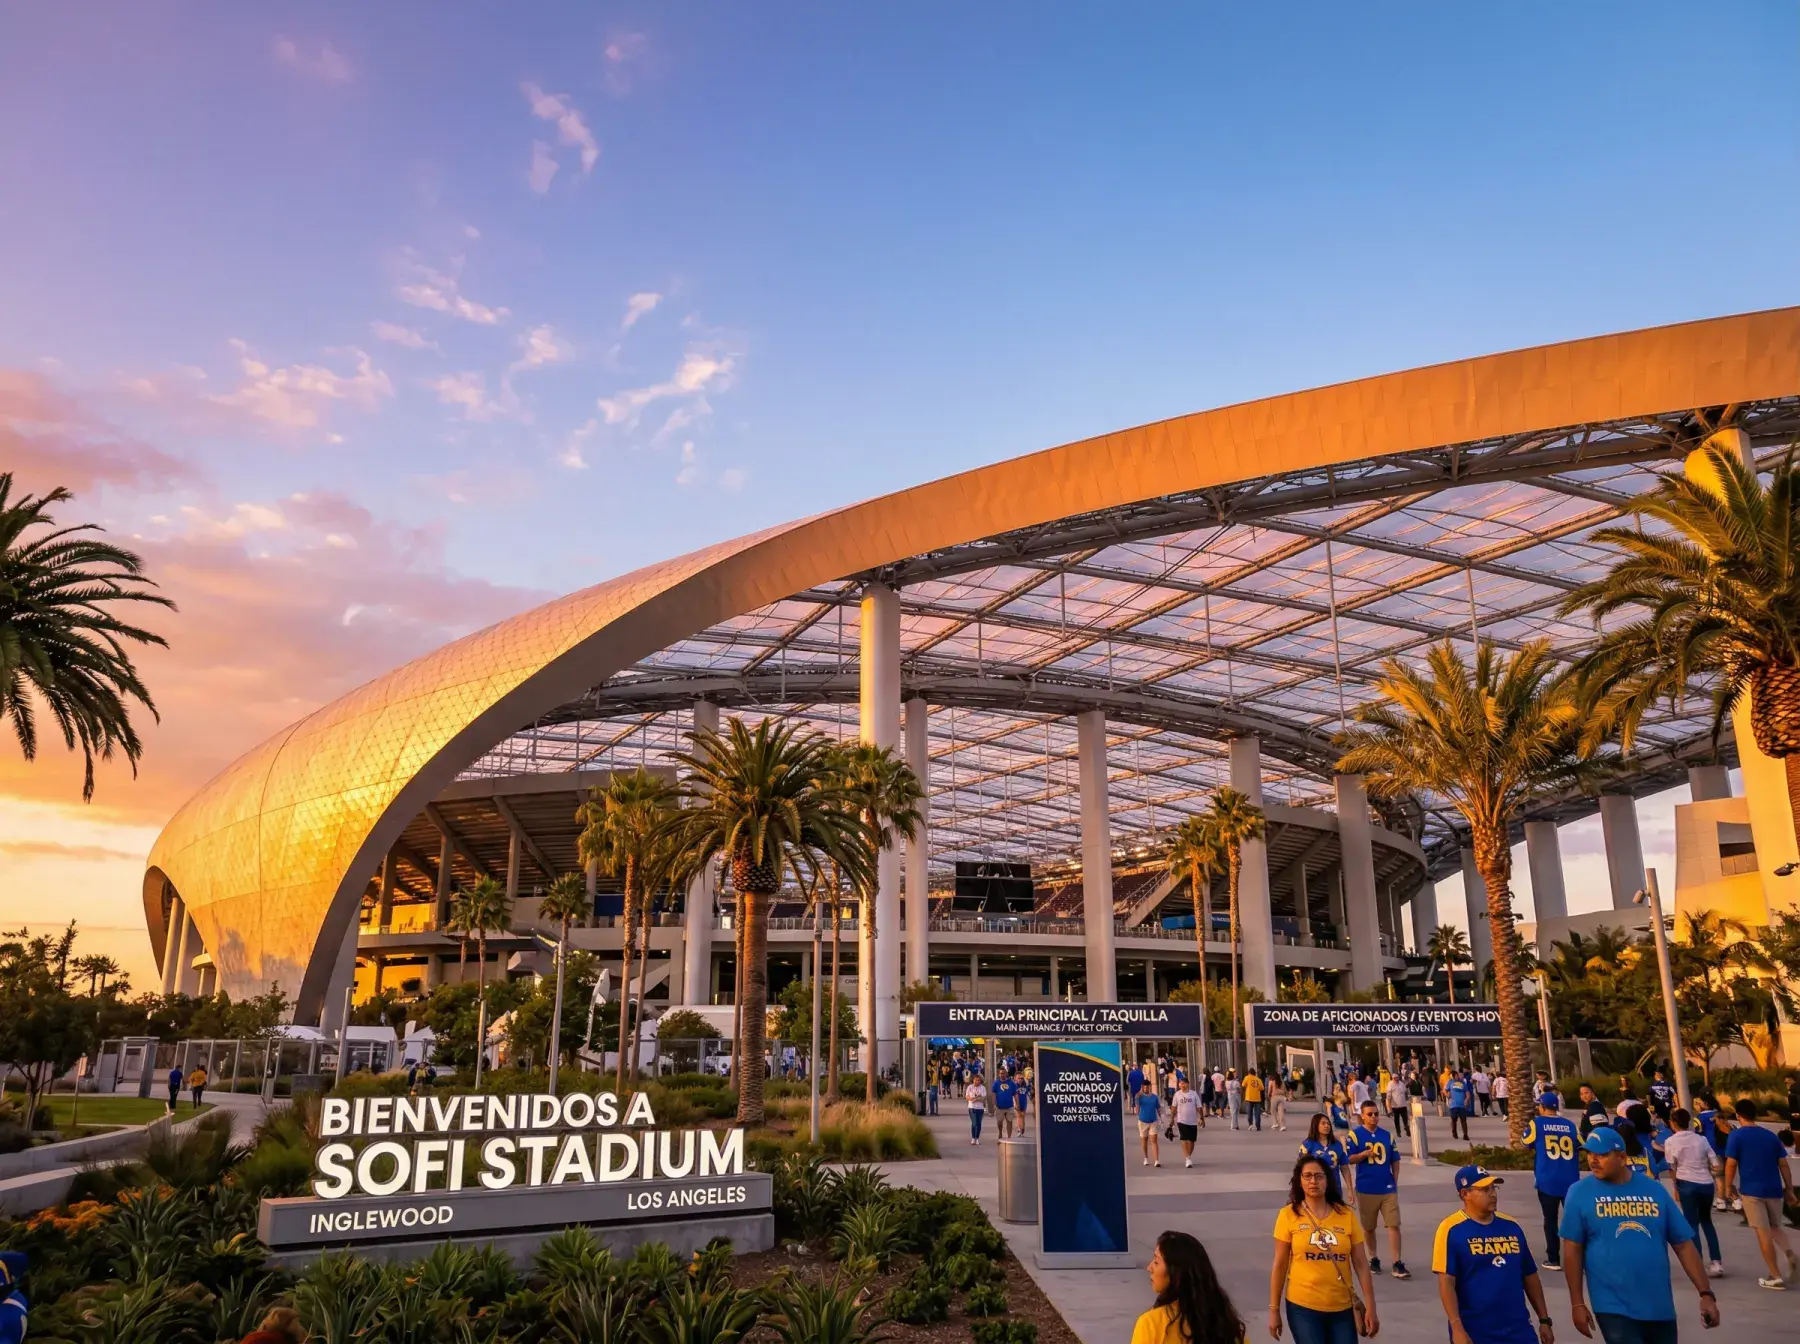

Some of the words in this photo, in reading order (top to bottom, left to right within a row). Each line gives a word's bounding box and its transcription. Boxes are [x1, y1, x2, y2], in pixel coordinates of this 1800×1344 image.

[949, 1009, 1014, 1021] ENTRADA
[1017, 1009, 1089, 1022] PRINCIPAL
[1100, 1009, 1169, 1022] TAQUILLA
[1263, 1010, 1300, 1022] ZONA
[1303, 1010, 1319, 1022] DE
[1321, 1010, 1408, 1022] AFICIONADOS
[1418, 1010, 1474, 1023] EVENTOS
[995, 1023, 1017, 1032] MAIN
[1018, 1023, 1061, 1032] ENTRANCE
[1067, 1023, 1095, 1032] TICKET
[1095, 1023, 1123, 1032] OFFICE
[1349, 1024, 1371, 1032] ZONE
[1410, 1024, 1440, 1032] EVENTS
[1058, 1071, 1087, 1081] ZONA
[1088, 1071, 1102, 1081] DE
[1043, 1083, 1112, 1093] AFICIONADOS
[1046, 1094, 1091, 1104] EVENTOS
[1092, 1093, 1114, 1104] HOY
[321, 1091, 618, 1136] BIENVENIDOS
[625, 1091, 655, 1126] A
[1063, 1106, 1078, 1114] FAN
[1078, 1106, 1098, 1114] ZONE
[1083, 1114, 1111, 1122] EVENTS
[1545, 1134, 1574, 1160] 59
[312, 1138, 465, 1199] SOFI
[481, 1127, 745, 1190] STADIUM
[627, 1191, 663, 1210] LOS
[666, 1185, 747, 1208] ANGELES
[1596, 1201, 1659, 1218] CHARGERS
[310, 1205, 454, 1234] INGLEWOOD
[1469, 1241, 1520, 1255] RAMS
